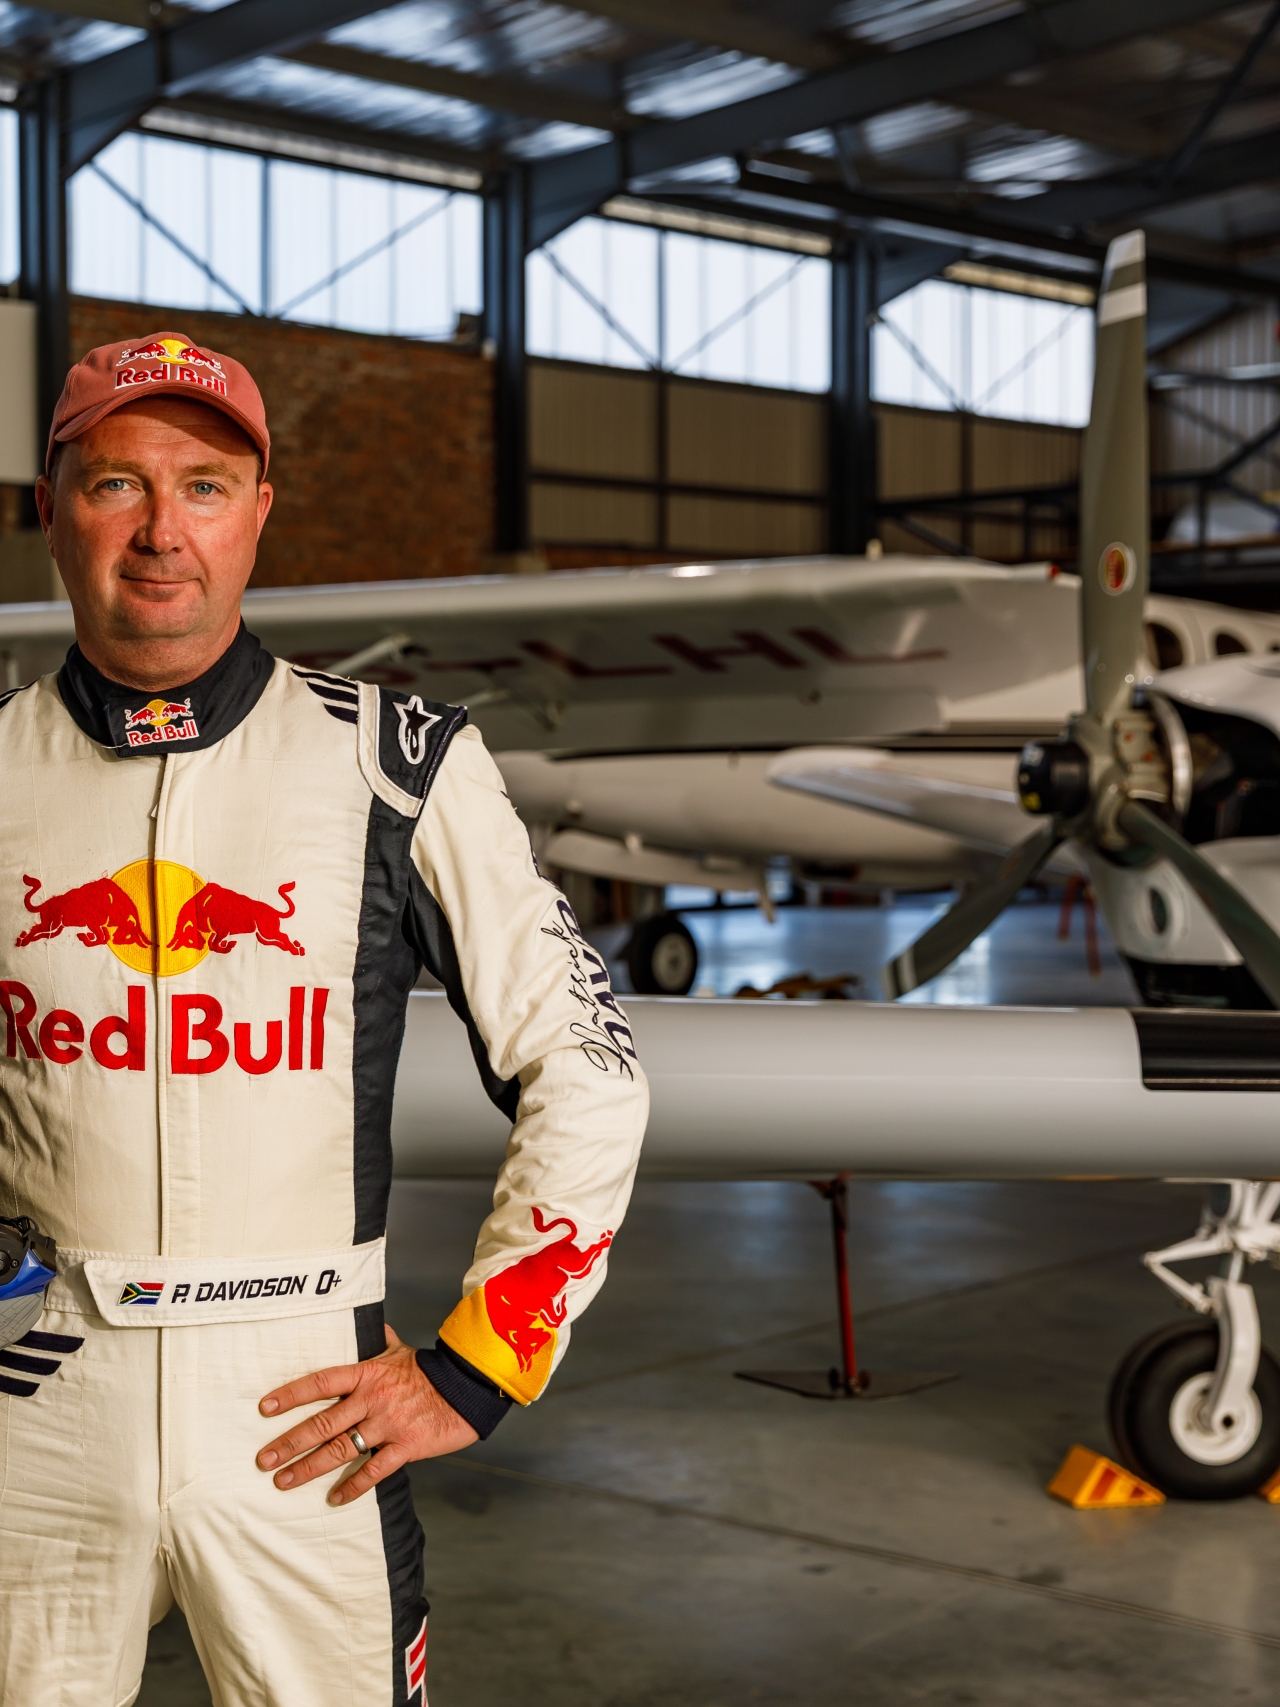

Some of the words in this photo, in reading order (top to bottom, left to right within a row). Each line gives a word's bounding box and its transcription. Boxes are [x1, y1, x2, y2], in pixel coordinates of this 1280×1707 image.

[114, 364, 170, 389] Red
[176, 366, 227, 396] Bull
[127, 725, 164, 746] Red
[164, 719, 198, 741] Bull
[540, 920, 634, 1082] Patrick
[171, 986, 330, 1075] Bull
[194, 1274, 309, 1303] DAVIDSON
